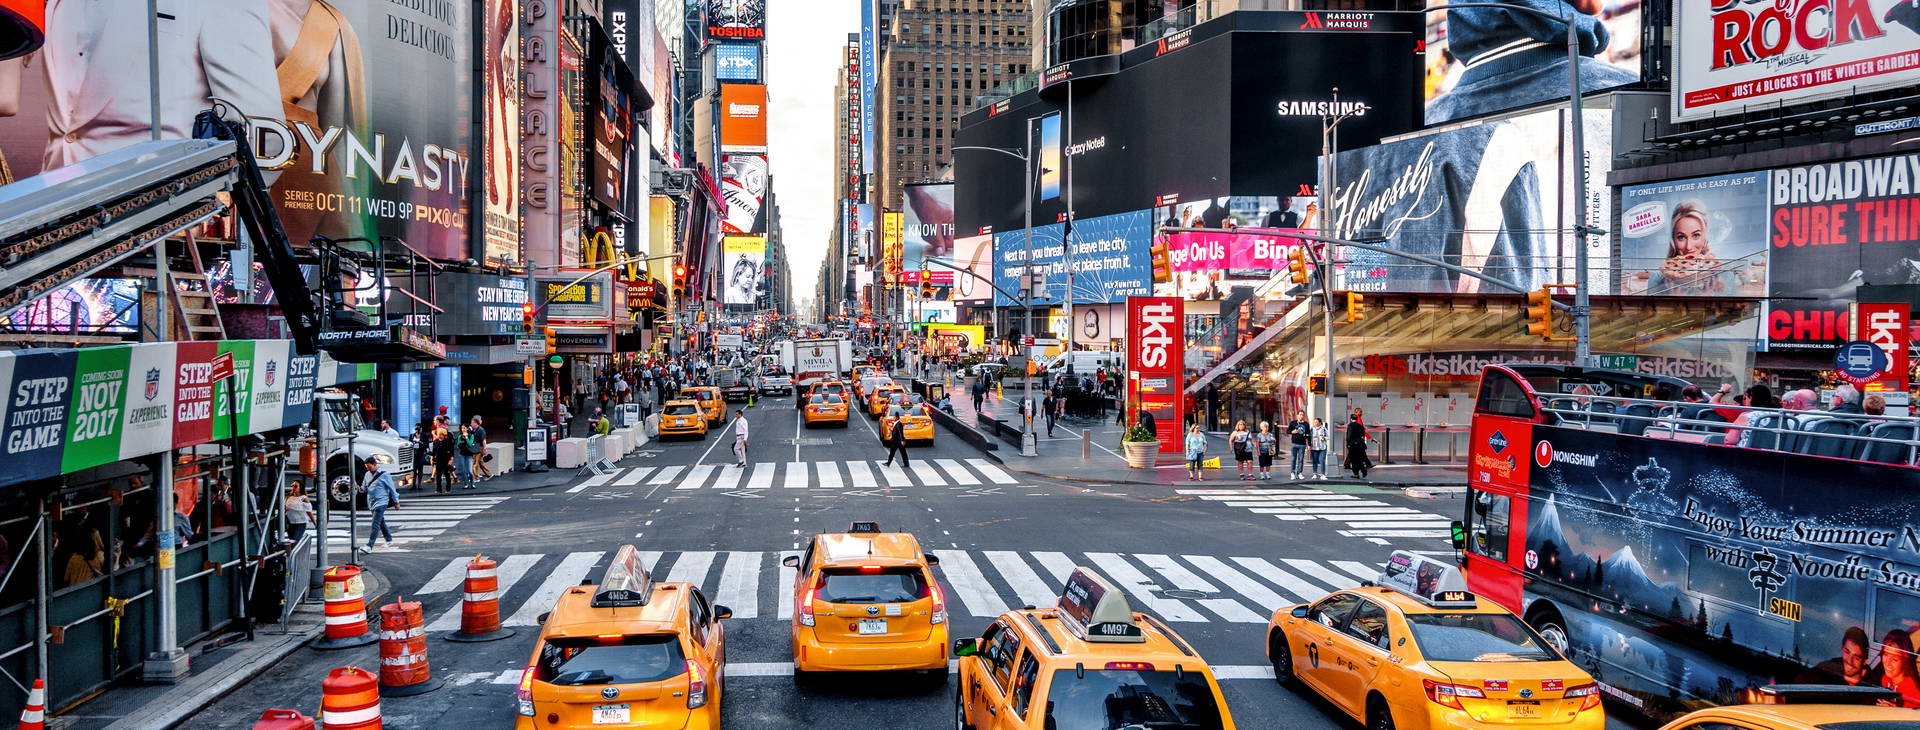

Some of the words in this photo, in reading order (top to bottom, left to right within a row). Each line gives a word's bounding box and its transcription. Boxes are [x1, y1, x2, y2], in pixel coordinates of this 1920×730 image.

[386, 14, 456, 64] DELICIOUS
[613, 11, 626, 62] EXPR
[708, 26, 764, 38] TOSHIBA
[1168, 28, 1193, 42] MARRIOTT
[1711, 0, 1887, 70] ROCK
[1168, 38, 1190, 51] MARQUIS
[1769, 55, 1780, 64] THE
[1777, 53, 1810, 68] MUSICAL
[1046, 63, 1070, 75] MARRIOTT
[1732, 82, 1754, 98] JUST
[1755, 80, 1762, 94] 4
[1763, 73, 1799, 92] BLOCKS
[1800, 72, 1813, 85] TO
[1815, 68, 1833, 83] THE
[1834, 61, 1875, 80] WINTER
[1876, 53, 1920, 72] GARDEN
[526, 0, 547, 208] PALACE
[1277, 101, 1366, 117] SAMSUNG
[1064, 143, 1087, 157] Galaxy
[1086, 135, 1105, 152] Note8
[246, 116, 469, 199] DYNASTY
[1637, 187, 1656, 196] ONLY
[1658, 186, 1673, 194] LIFE
[1674, 183, 1695, 191] WERE
[1697, 182, 1708, 190] AS
[1709, 179, 1728, 188] EASY
[1730, 178, 1741, 186] AS
[1743, 176, 1756, 184] PIE
[1773, 155, 1920, 205] BROADWAY
[285, 189, 314, 201] SERIES
[1330, 141, 1443, 240] Honestly
[284, 201, 314, 210] PREMIERE
[316, 192, 345, 212] OCT
[348, 197, 361, 214] 11
[366, 198, 396, 219] WED
[399, 202, 413, 220] 9P
[1592, 191, 1600, 248] OUFITTERS
[1628, 216, 1661, 231] BAREILLES
[1635, 212, 1652, 221] SARA
[908, 223, 938, 236] KNOW
[1772, 204, 1848, 248] SURE
[1004, 250, 1018, 262] Next
[1031, 249, 1043, 261] you
[1079, 241, 1097, 253] leave
[1098, 239, 1111, 251] the
[1111, 237, 1127, 252] city,
[1190, 242, 1207, 260] On
[1208, 240, 1225, 260] Us
[1053, 261, 1064, 273] the
[1081, 257, 1102, 273] places
[1103, 256, 1122, 270] from
[1122, 254, 1131, 269] it.
[1350, 270, 1367, 279] THE
[1115, 288, 1126, 296] OUT
[1126, 288, 1134, 296] OF
[1118, 280, 1141, 288] UNITED
[1348, 282, 1387, 291] AMERICA
[478, 286, 496, 302] STAY
[496, 287, 503, 302] IN
[503, 288, 513, 303] THE
[483, 306, 499, 321] NEW
[318, 331, 353, 340] NORTH
[354, 329, 389, 339] SHORE
[1142, 302, 1175, 369] tkts
[289, 357, 315, 375] STEP
[803, 358, 833, 366] MIVILA
[1601, 356, 1610, 367] W
[1614, 356, 1626, 367] 47
[82, 371, 107, 384] COMING
[107, 369, 124, 380] SOON
[179, 362, 212, 385] STEP
[288, 378, 303, 389] INTO
[303, 376, 314, 387] THE
[1838, 370, 1847, 379] NO
[1848, 371, 1881, 384] STANDING
[15, 376, 68, 408] STEP
[77, 380, 122, 413] NOV
[178, 388, 198, 401] INTO
[197, 386, 212, 399] THE
[287, 388, 312, 406] GAME
[1591, 384, 1607, 392] WAY
[218, 392, 249, 417] 217
[255, 390, 281, 406] EXPERIENCE
[1382, 397, 1389, 406] 2
[1416, 397, 1424, 406] 3
[1450, 398, 1457, 406] 4
[11, 409, 43, 427] INTO
[42, 405, 65, 422] THE
[129, 404, 168, 424] EXPERIENCE
[177, 402, 210, 423] GAME
[72, 408, 119, 443] 2017
[7, 423, 62, 454] GAME
[1553, 450, 1595, 468] NONGSHIM
[1683, 496, 1737, 538] Enjoy
[1738, 516, 1787, 541] Your
[1790, 520, 1896, 548] Summer
[1705, 543, 1748, 569] with
[1787, 552, 1870, 581] Noodle
[1770, 597, 1801, 622] SHIN
[1101, 623, 1128, 635] 4M97
